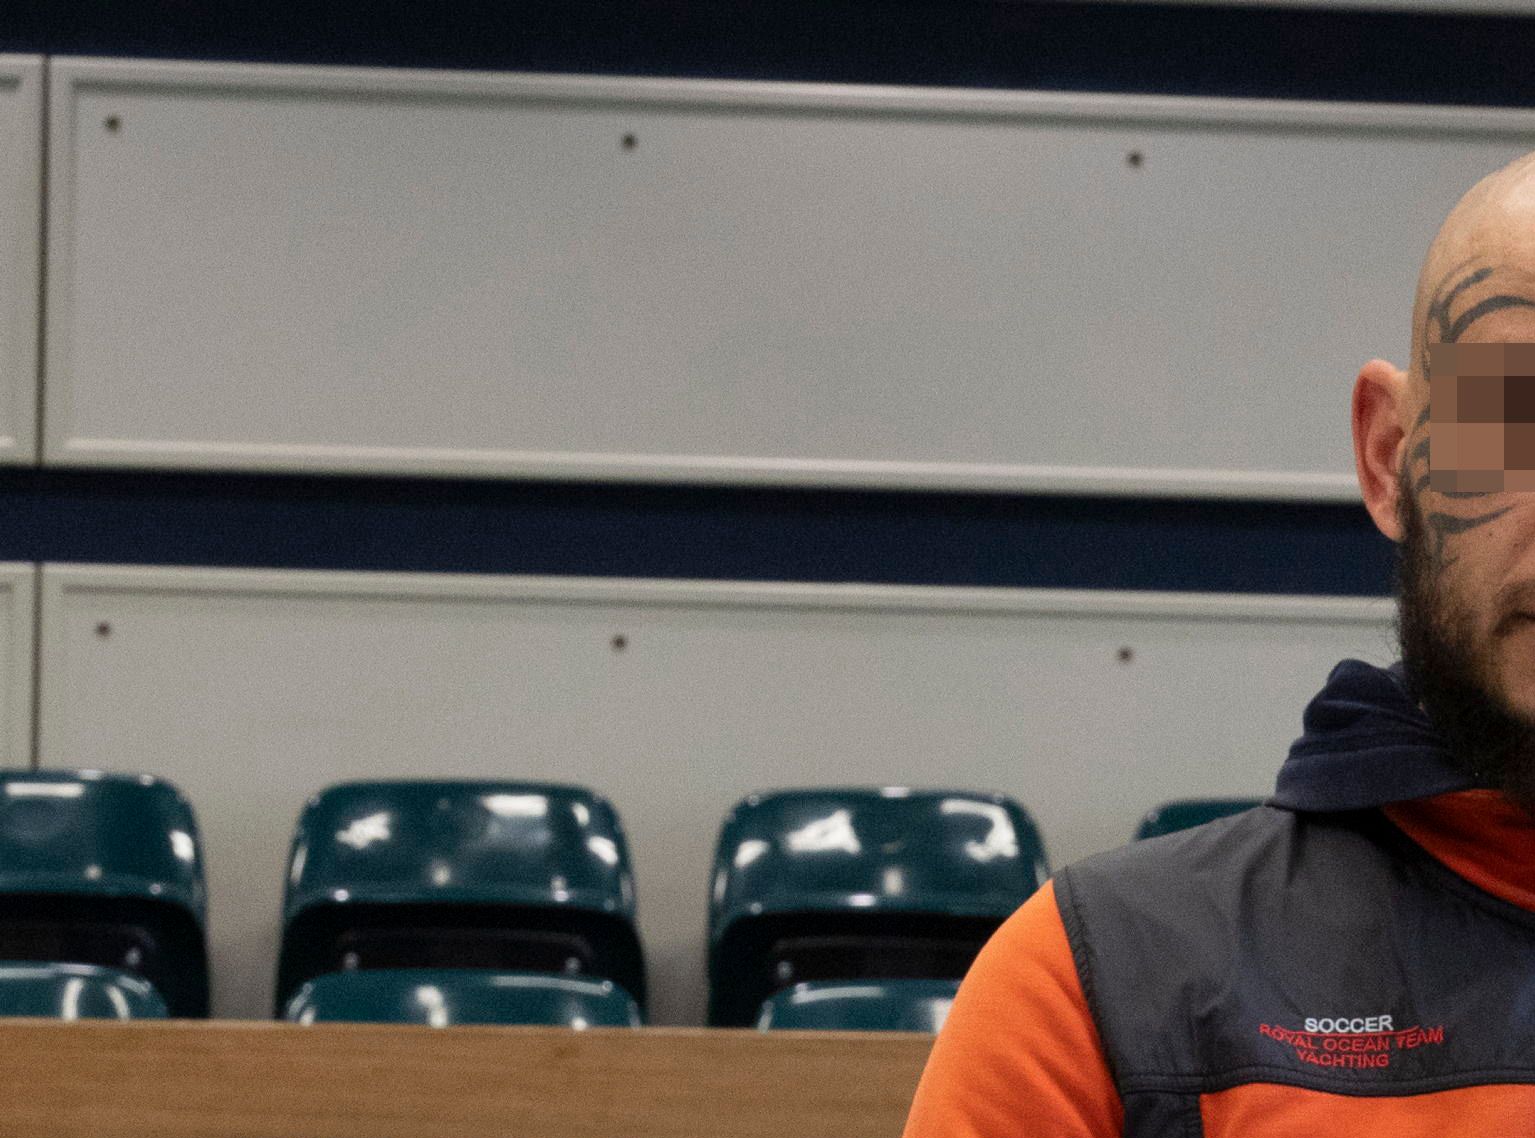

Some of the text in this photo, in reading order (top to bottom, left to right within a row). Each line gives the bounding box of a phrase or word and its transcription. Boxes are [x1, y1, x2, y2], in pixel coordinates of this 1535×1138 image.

[1304, 1014, 1394, 1034] SOCCER
[1258, 1023, 1445, 1051] ROYAL OCEAN TEAM
[1296, 1049, 1390, 1068] YACHTING
